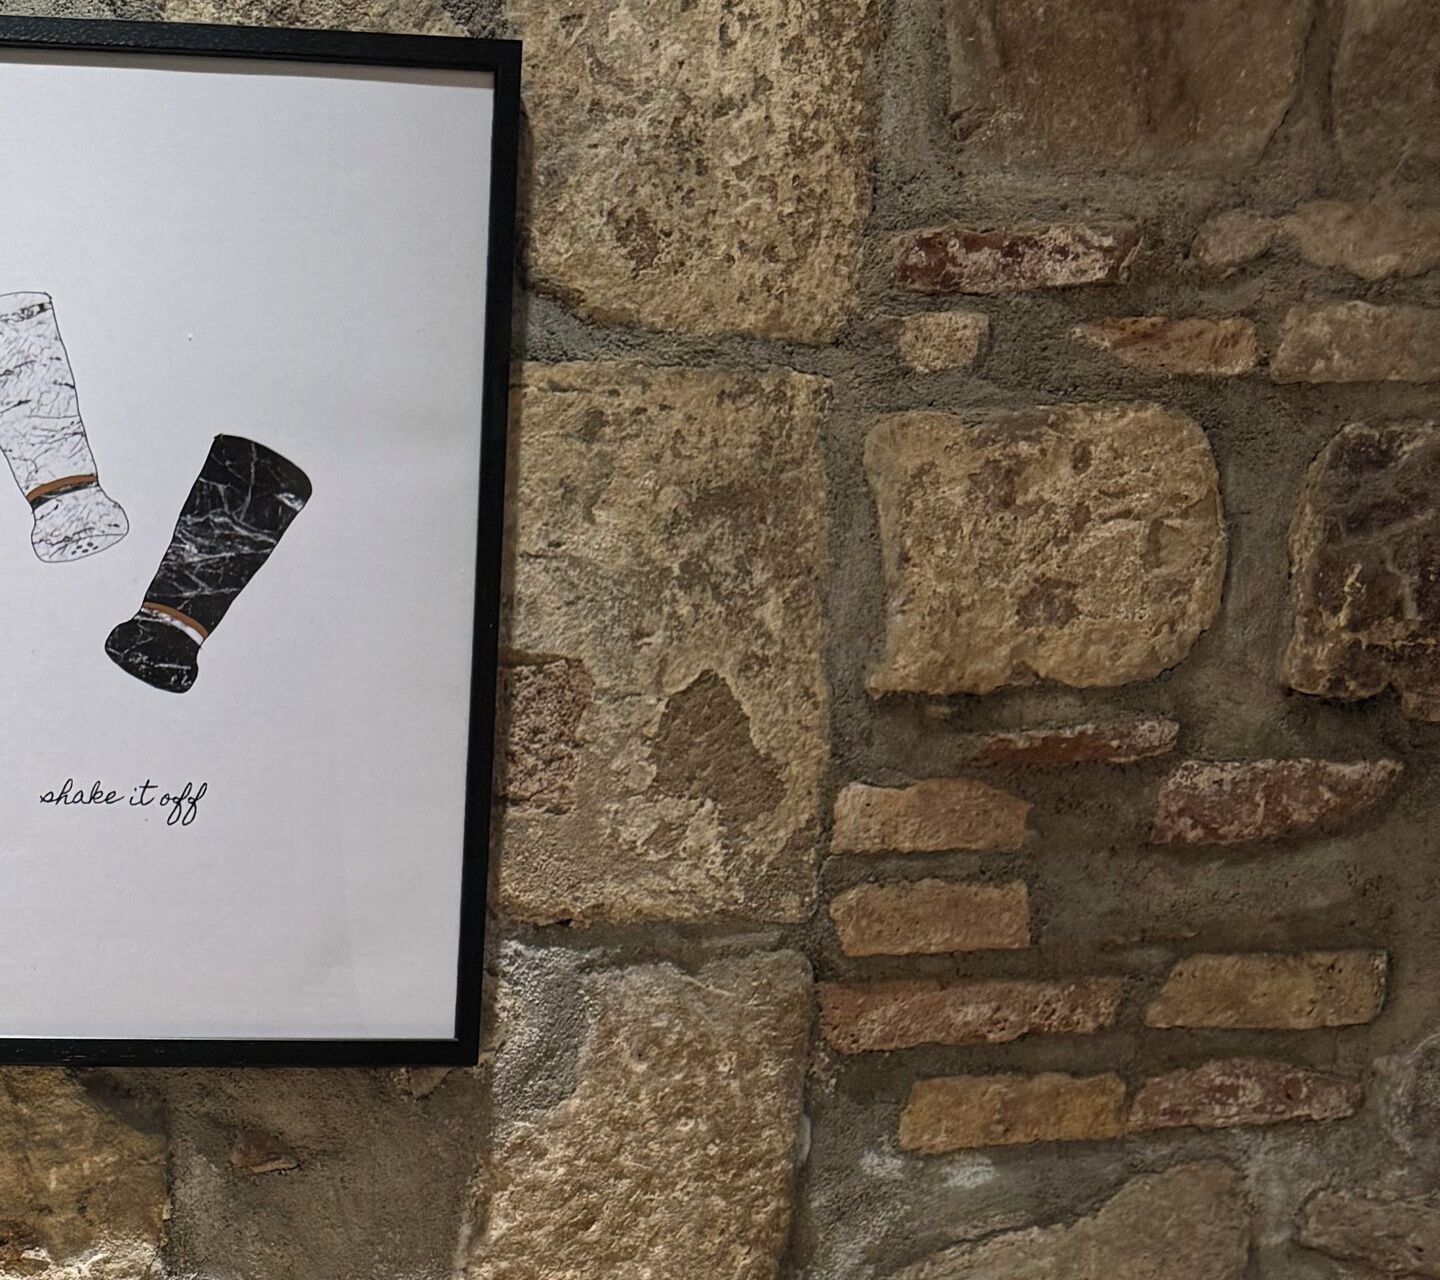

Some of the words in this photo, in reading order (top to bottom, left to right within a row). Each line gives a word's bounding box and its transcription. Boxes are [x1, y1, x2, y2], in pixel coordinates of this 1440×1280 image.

[39, 778, 125, 806] shake
[129, 779, 158, 806] it
[160, 782, 208, 826] off
